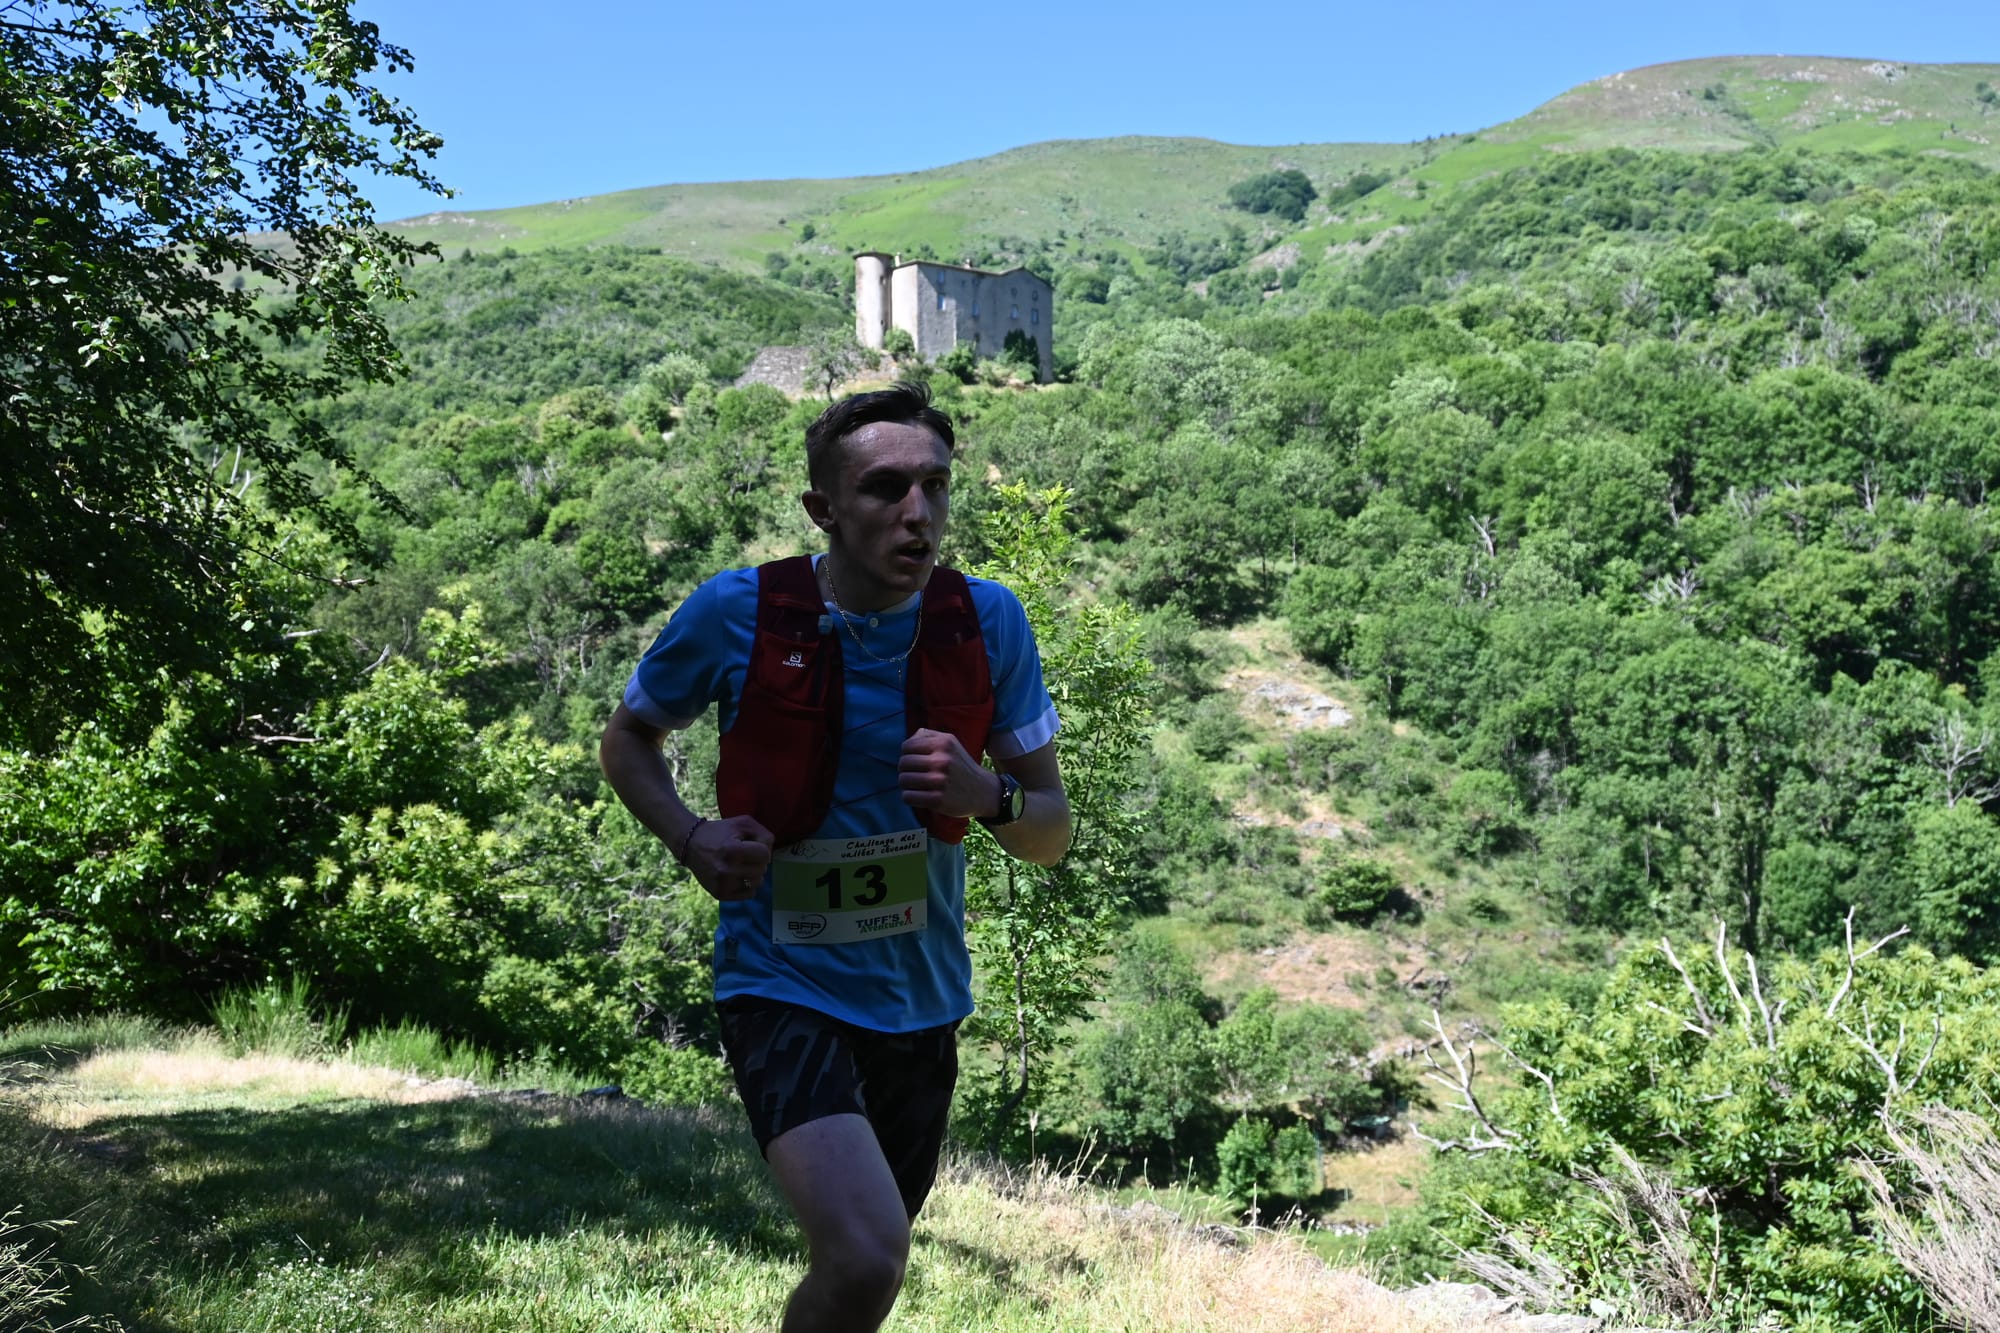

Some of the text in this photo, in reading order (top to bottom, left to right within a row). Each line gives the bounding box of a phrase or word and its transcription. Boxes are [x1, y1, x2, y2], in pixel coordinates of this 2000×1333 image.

[846, 834, 916, 849] Challenge des
[816, 865, 887, 909] 13
[788, 921, 822, 930] BFP
[856, 914, 900, 928] TUFF'S
